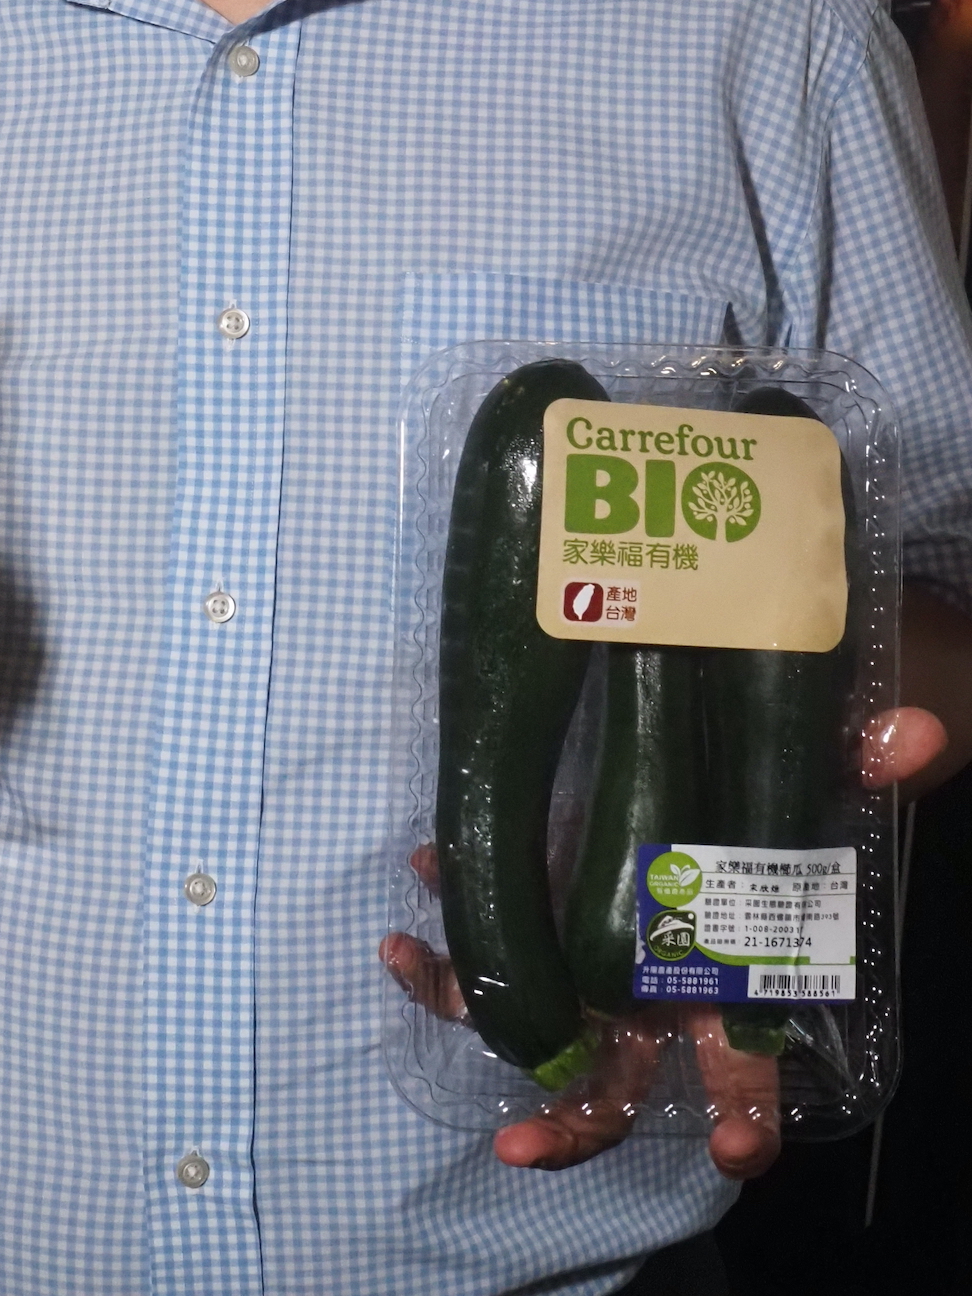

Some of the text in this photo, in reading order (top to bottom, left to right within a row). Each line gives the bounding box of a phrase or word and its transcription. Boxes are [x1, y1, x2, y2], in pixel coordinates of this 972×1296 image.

[566, 416, 757, 461] Carrefour
[564, 453, 761, 543] BIO
[562, 538, 699, 571] 家樂福有機
[606, 585, 637, 603] 產地
[606, 605, 637, 622] 台灣
[744, 936, 812, 948] 21-1671374
[666, 976, 719, 985] 05-5881961
[666, 985, 719, 995] 05-5881963
